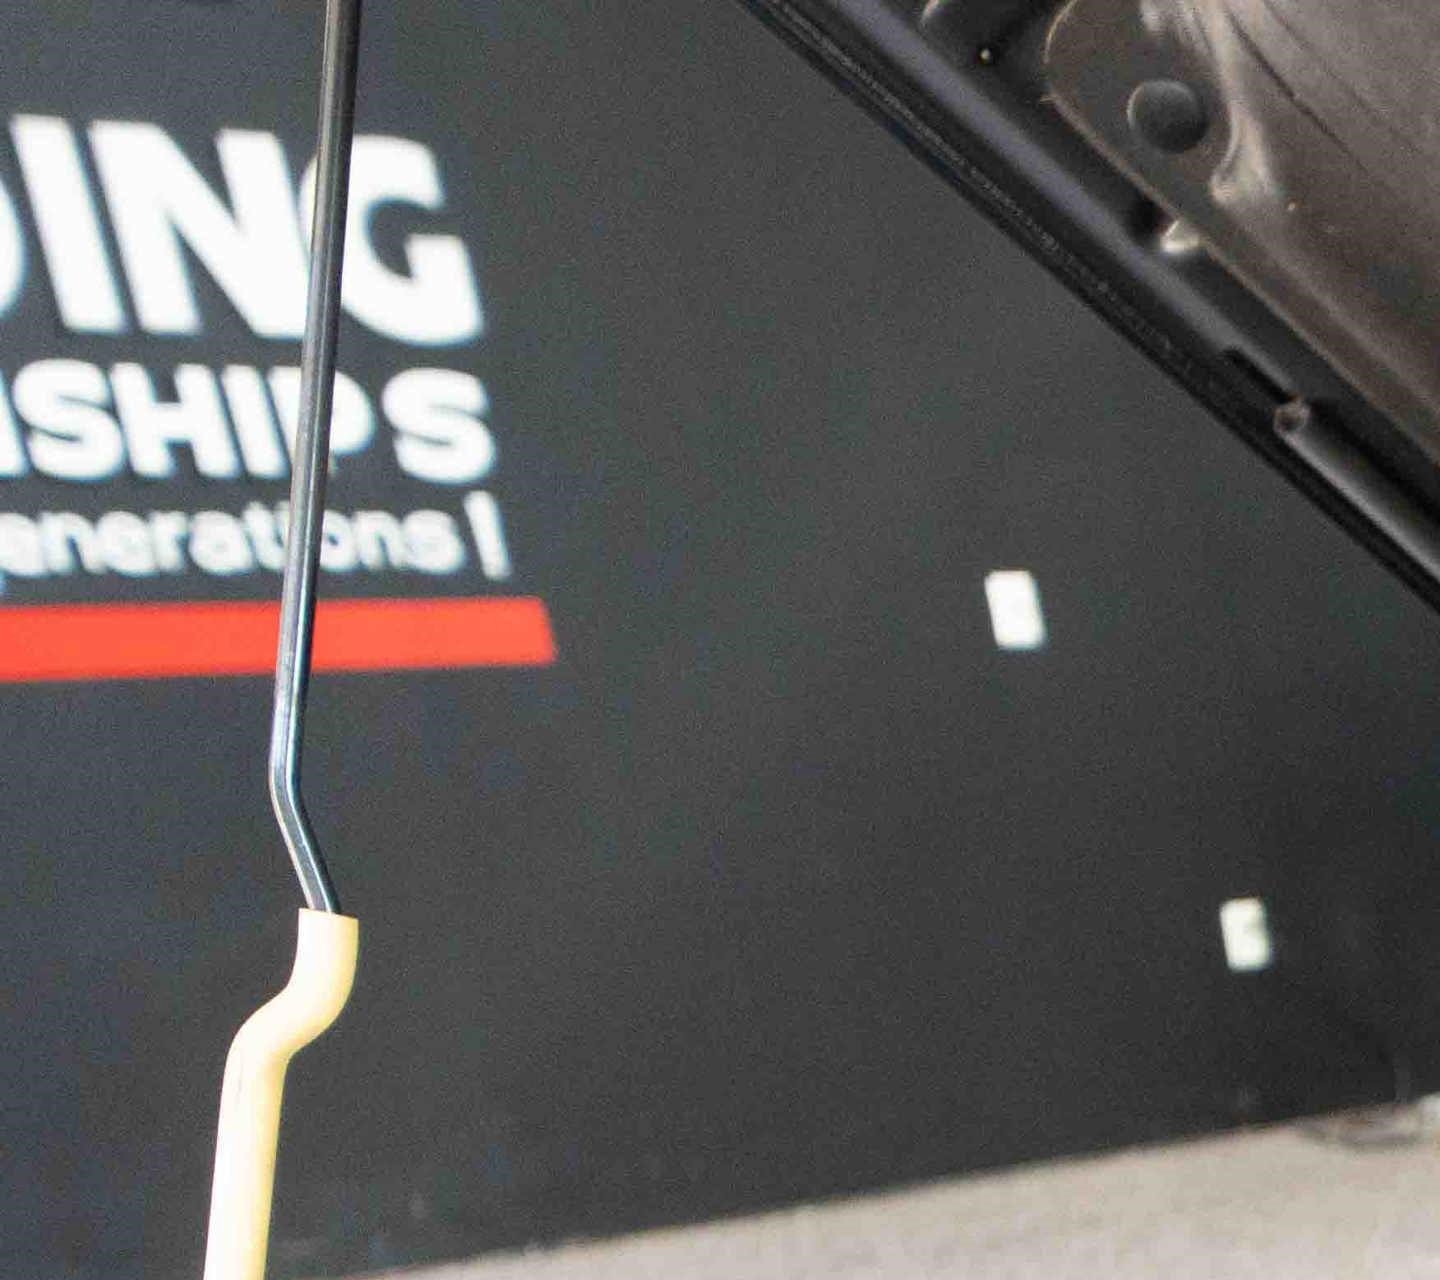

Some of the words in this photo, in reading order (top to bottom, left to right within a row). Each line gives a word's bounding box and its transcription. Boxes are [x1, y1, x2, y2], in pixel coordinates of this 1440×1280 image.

[0, 113, 484, 346] ING
[0, 358, 497, 484] SHIPS
[0, 490, 511, 592] enerations!
